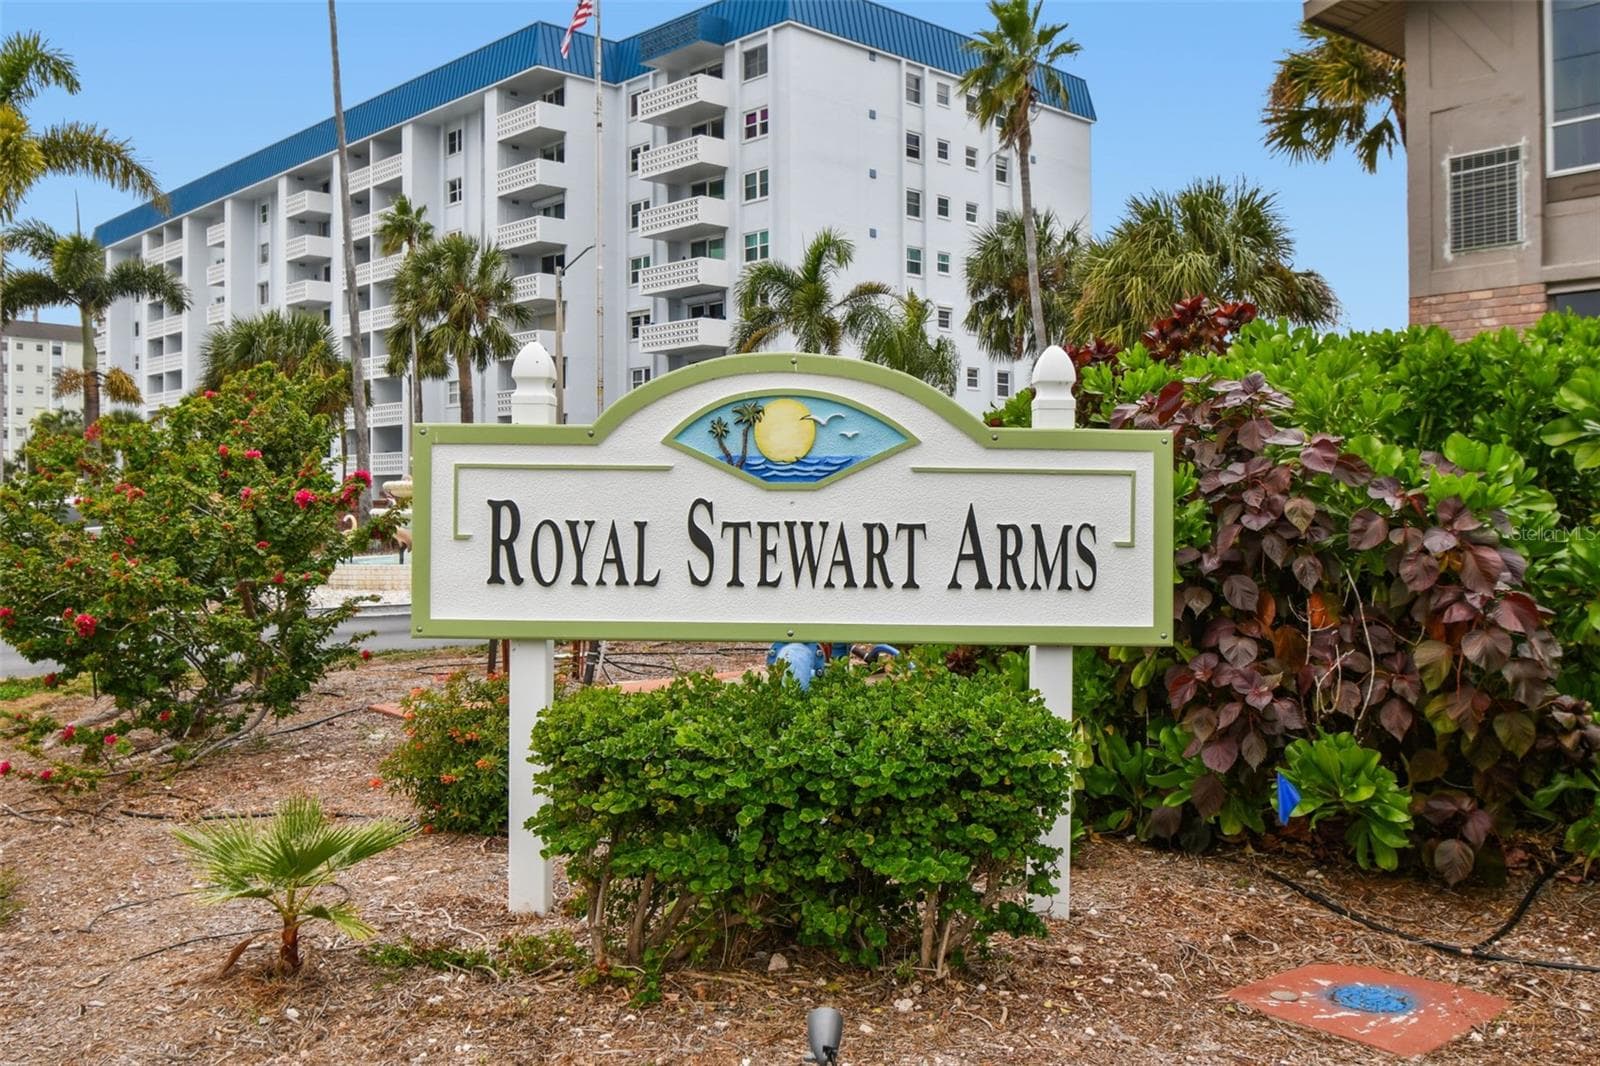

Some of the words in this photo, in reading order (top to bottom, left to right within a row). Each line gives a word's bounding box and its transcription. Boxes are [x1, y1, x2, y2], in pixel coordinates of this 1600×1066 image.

[486, 499, 661, 588] ROYAL
[687, 497, 927, 590] STEWART
[947, 503, 1097, 592] ARMS
